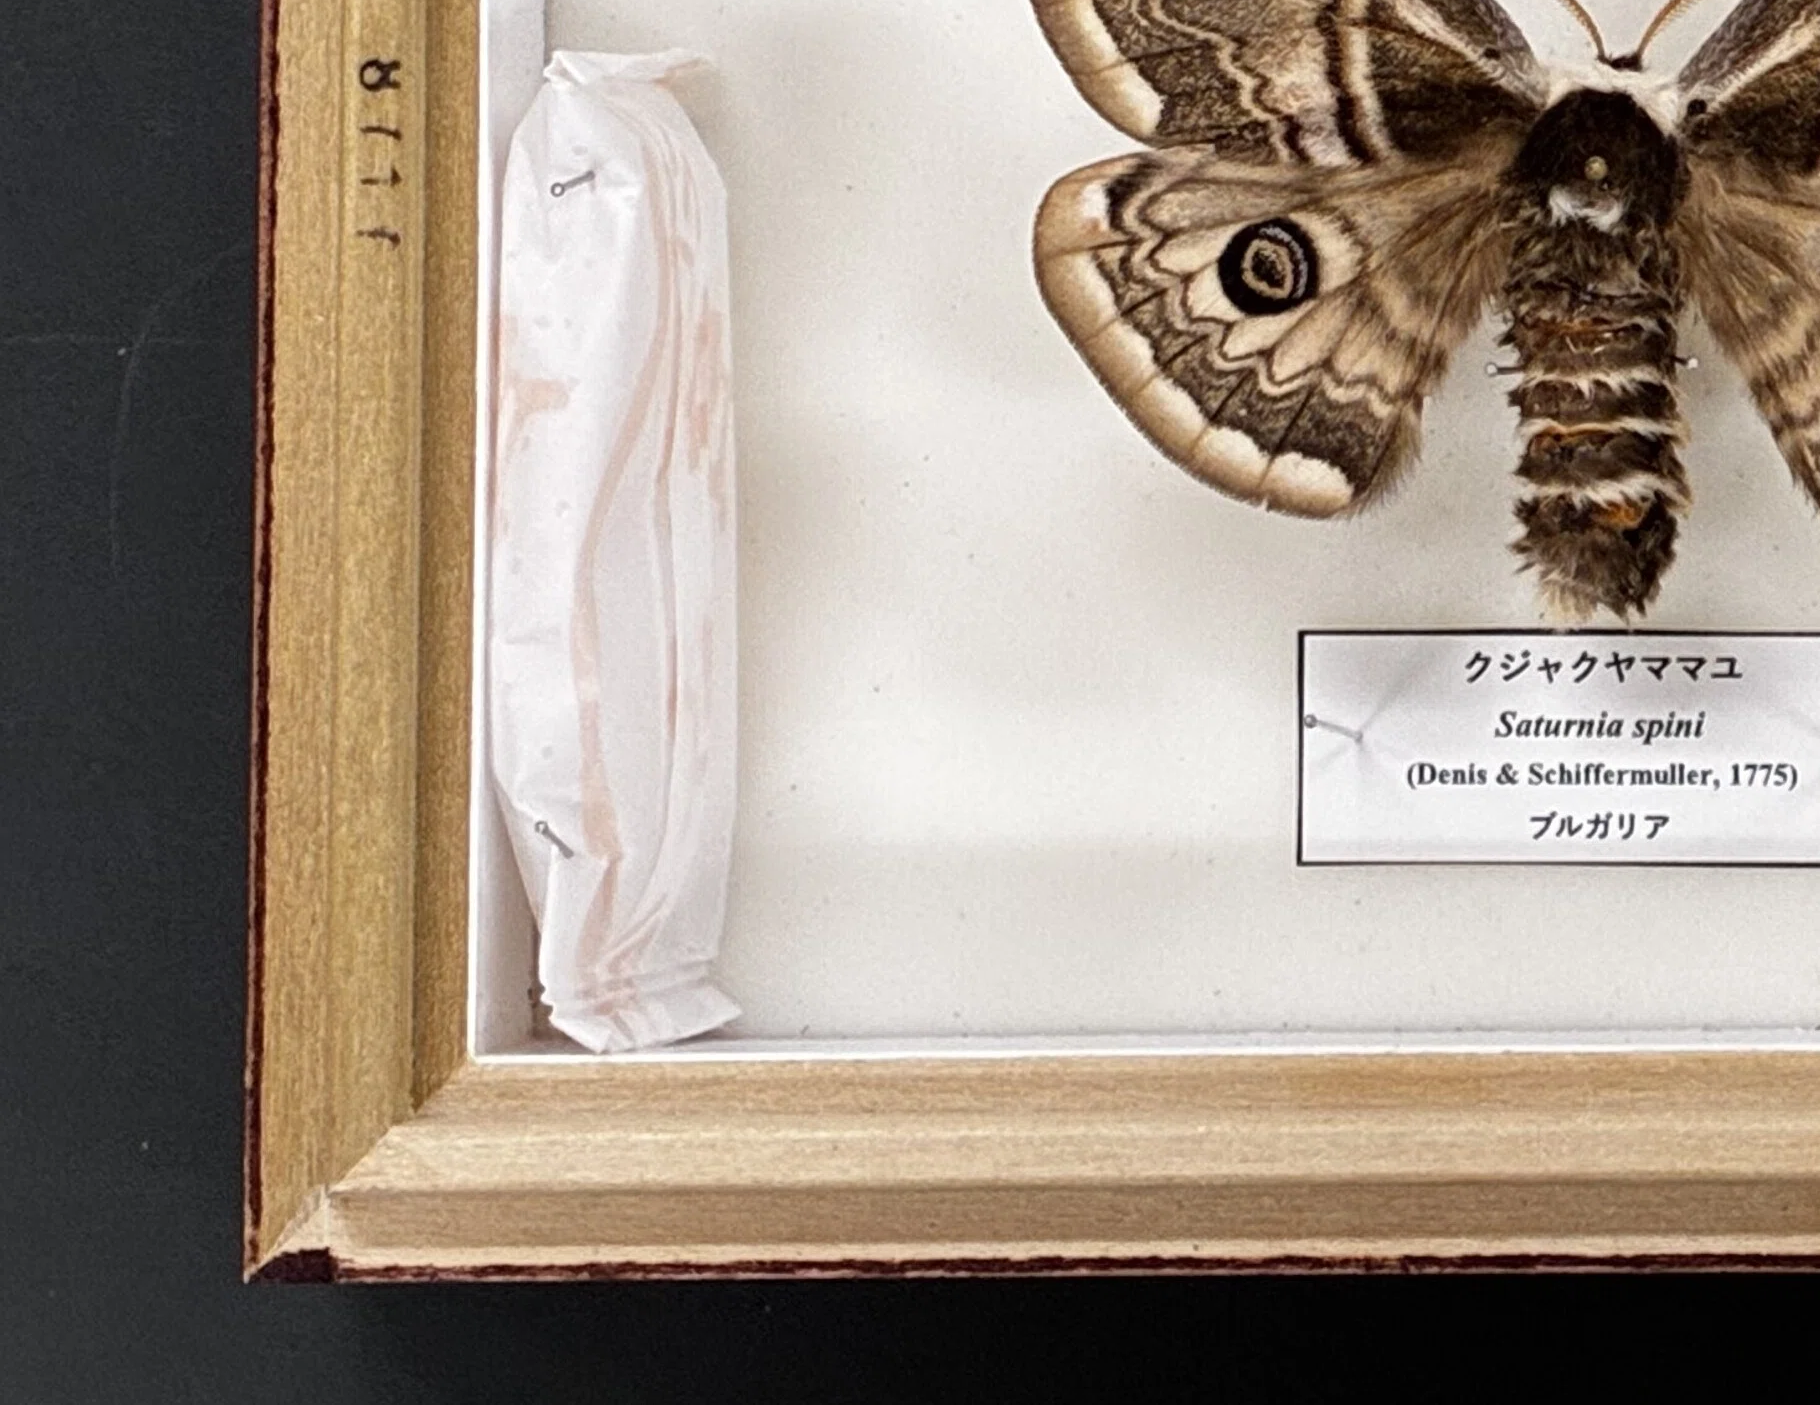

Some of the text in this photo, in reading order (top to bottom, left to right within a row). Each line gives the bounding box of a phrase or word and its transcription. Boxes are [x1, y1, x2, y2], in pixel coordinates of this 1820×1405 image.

[1465, 650, 1743, 683] クジャクヤママユ
[1494, 710, 1706, 746] Saturnia spini
[1406, 762, 1799, 790] (Denis & Schiffermuller, 1775)
[1529, 811, 1670, 841] ブルガリア
